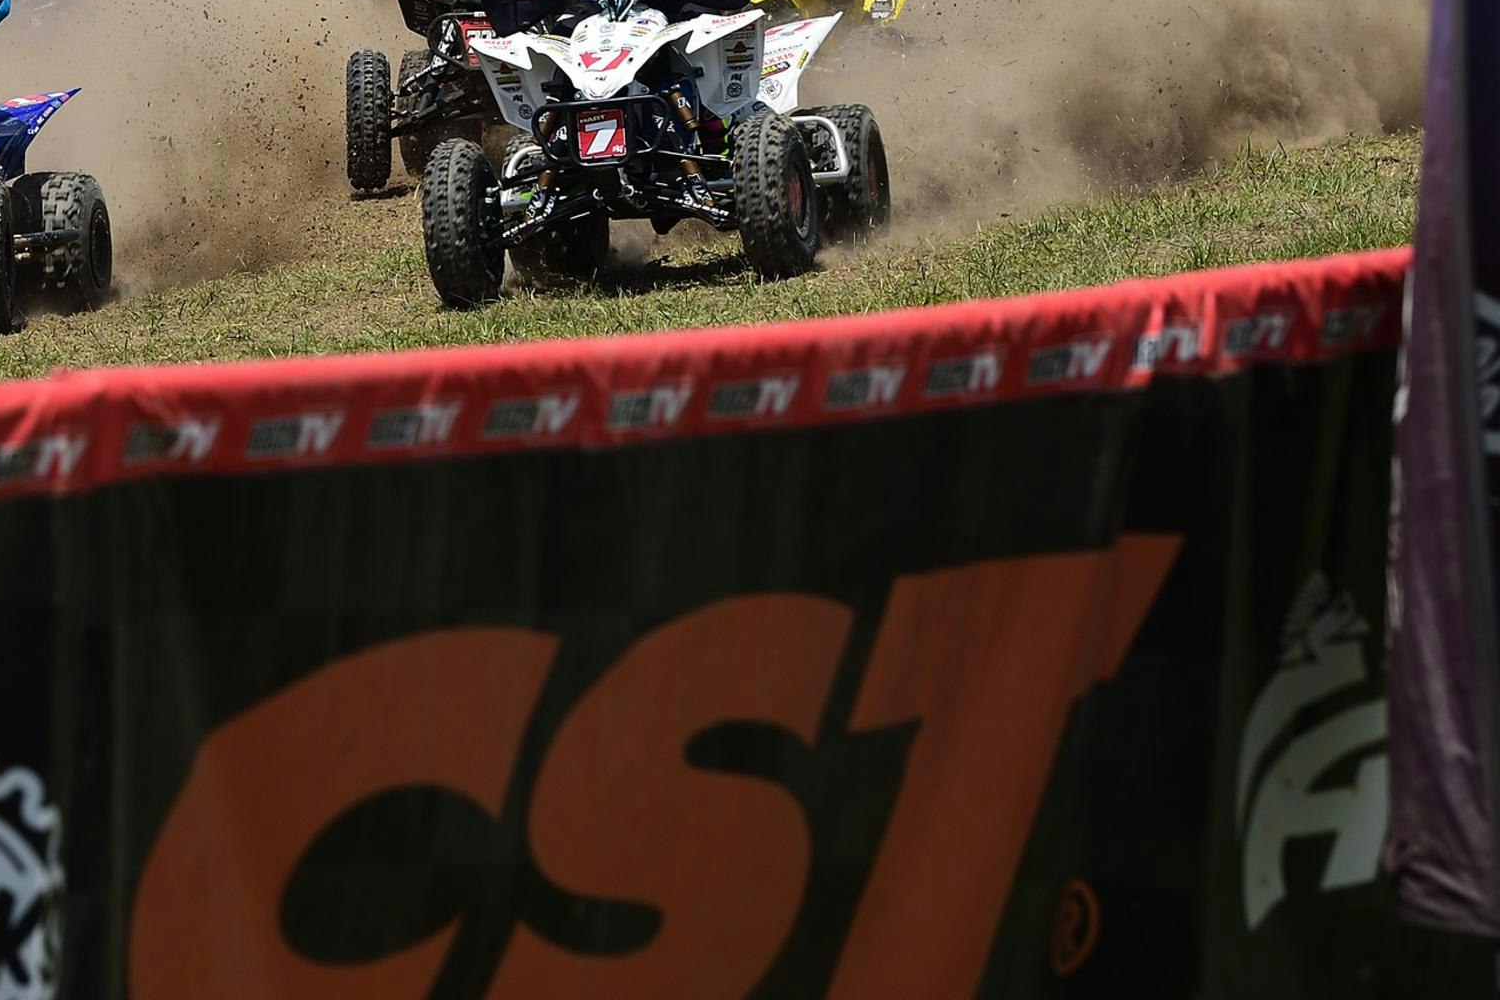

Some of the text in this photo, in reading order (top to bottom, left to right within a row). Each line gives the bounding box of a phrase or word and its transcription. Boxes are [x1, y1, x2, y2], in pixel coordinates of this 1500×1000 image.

[579, 114, 605, 123] HART
[584, 119, 618, 155] 7
[126, 532, 1187, 1000] CST
